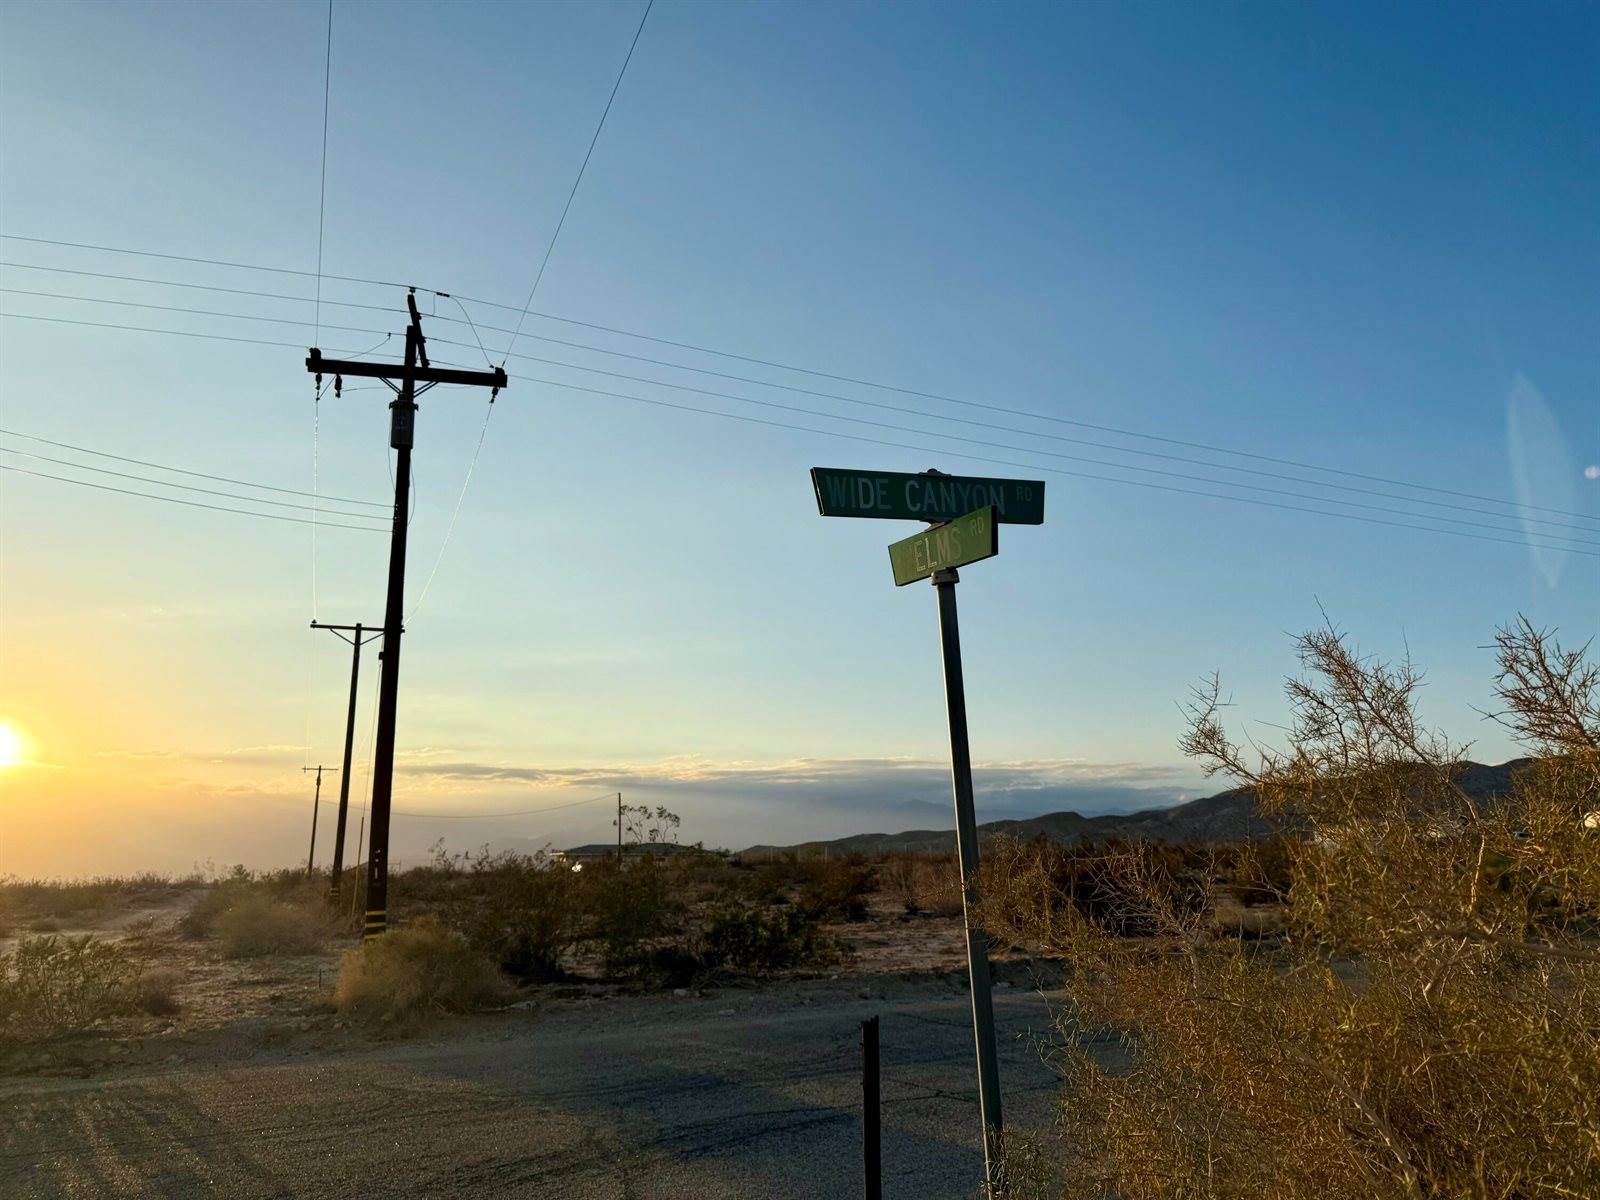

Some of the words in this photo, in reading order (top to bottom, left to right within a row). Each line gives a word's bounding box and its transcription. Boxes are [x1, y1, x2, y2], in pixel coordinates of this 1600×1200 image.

[826, 475, 892, 510] WIDE
[905, 480, 1005, 515] CANYON
[1016, 486, 1033, 502] RD
[913, 527, 961, 572] ELMS
[971, 517, 985, 537] RD
